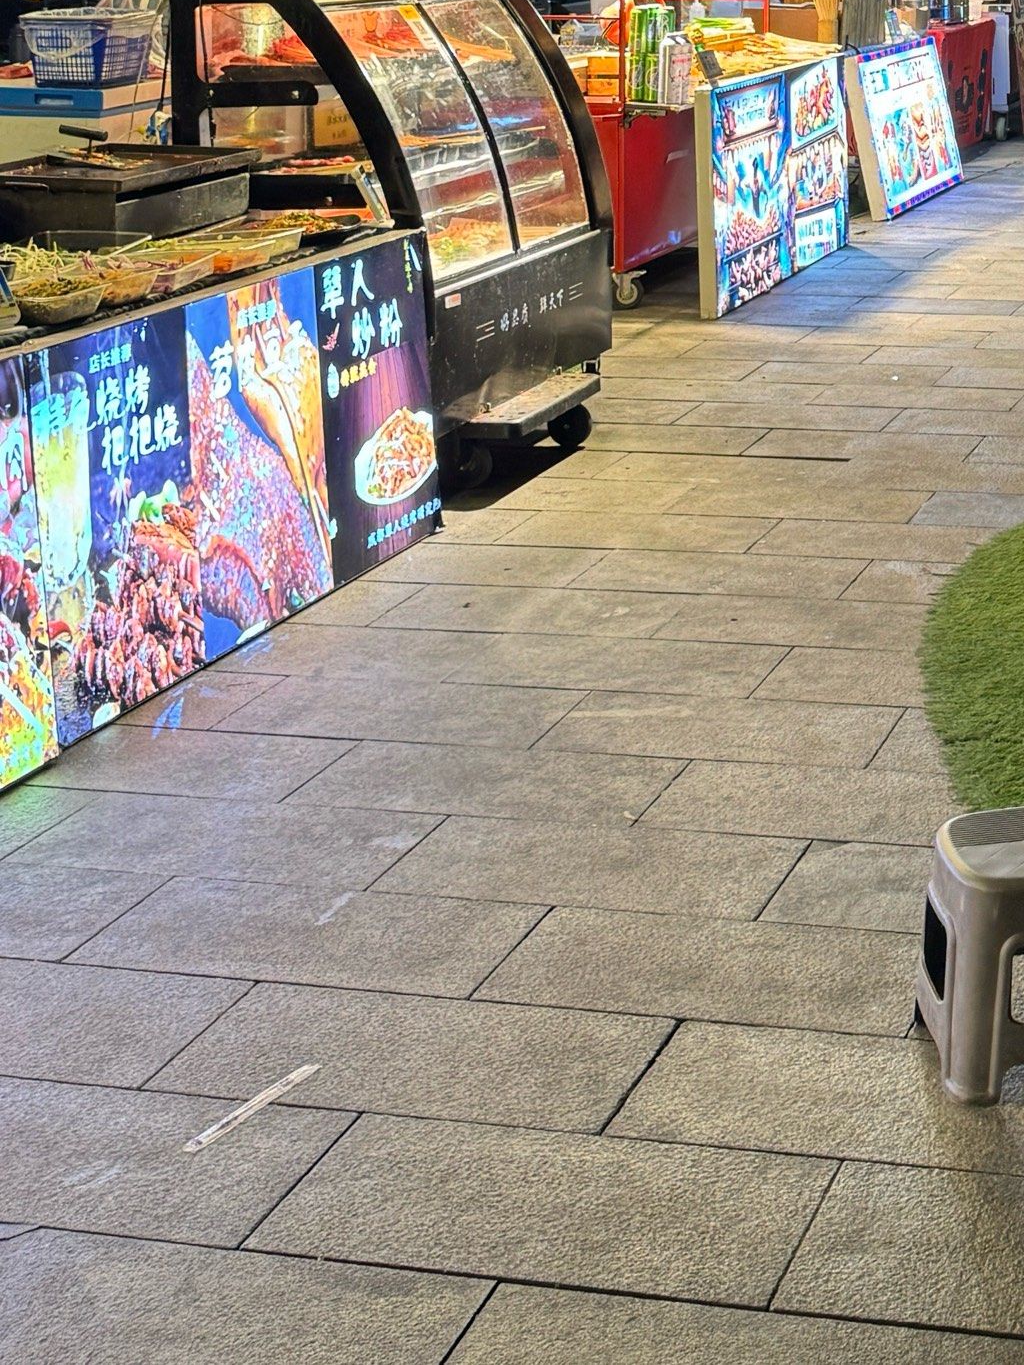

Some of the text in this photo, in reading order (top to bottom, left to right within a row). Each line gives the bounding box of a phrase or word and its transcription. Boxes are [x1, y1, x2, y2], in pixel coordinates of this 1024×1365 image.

[352, 297, 404, 360] 炒粉
[88, 342, 133, 375] 店长推荐
